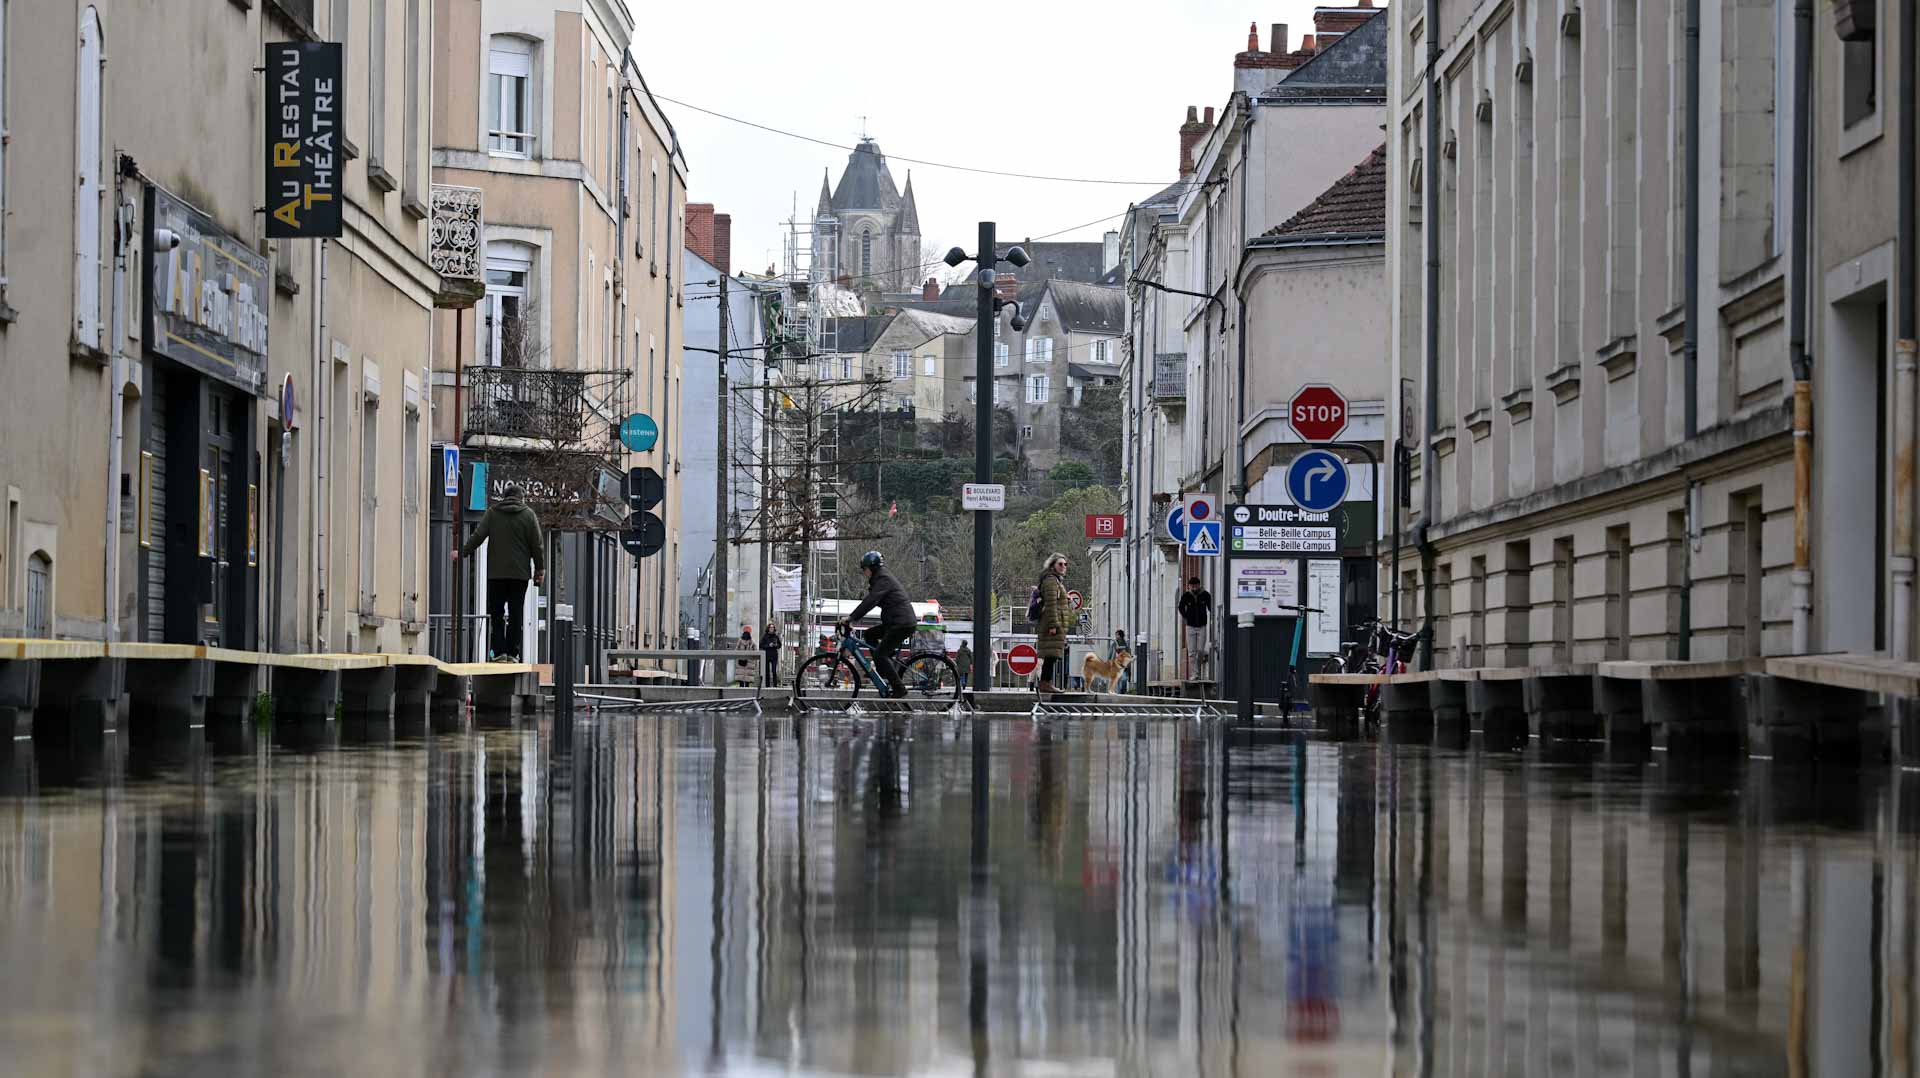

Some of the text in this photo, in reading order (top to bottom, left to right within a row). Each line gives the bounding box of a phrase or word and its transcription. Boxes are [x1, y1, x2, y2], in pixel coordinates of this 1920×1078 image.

[1295, 405, 1341, 422] STOP
[1258, 508, 1329, 522] Doutre-Maine
[1096, 518, 1112, 531] HB
[1234, 528, 1331, 540] B Belle-Beille Campus
[1234, 540, 1331, 552] C Belle-Beille Campus
